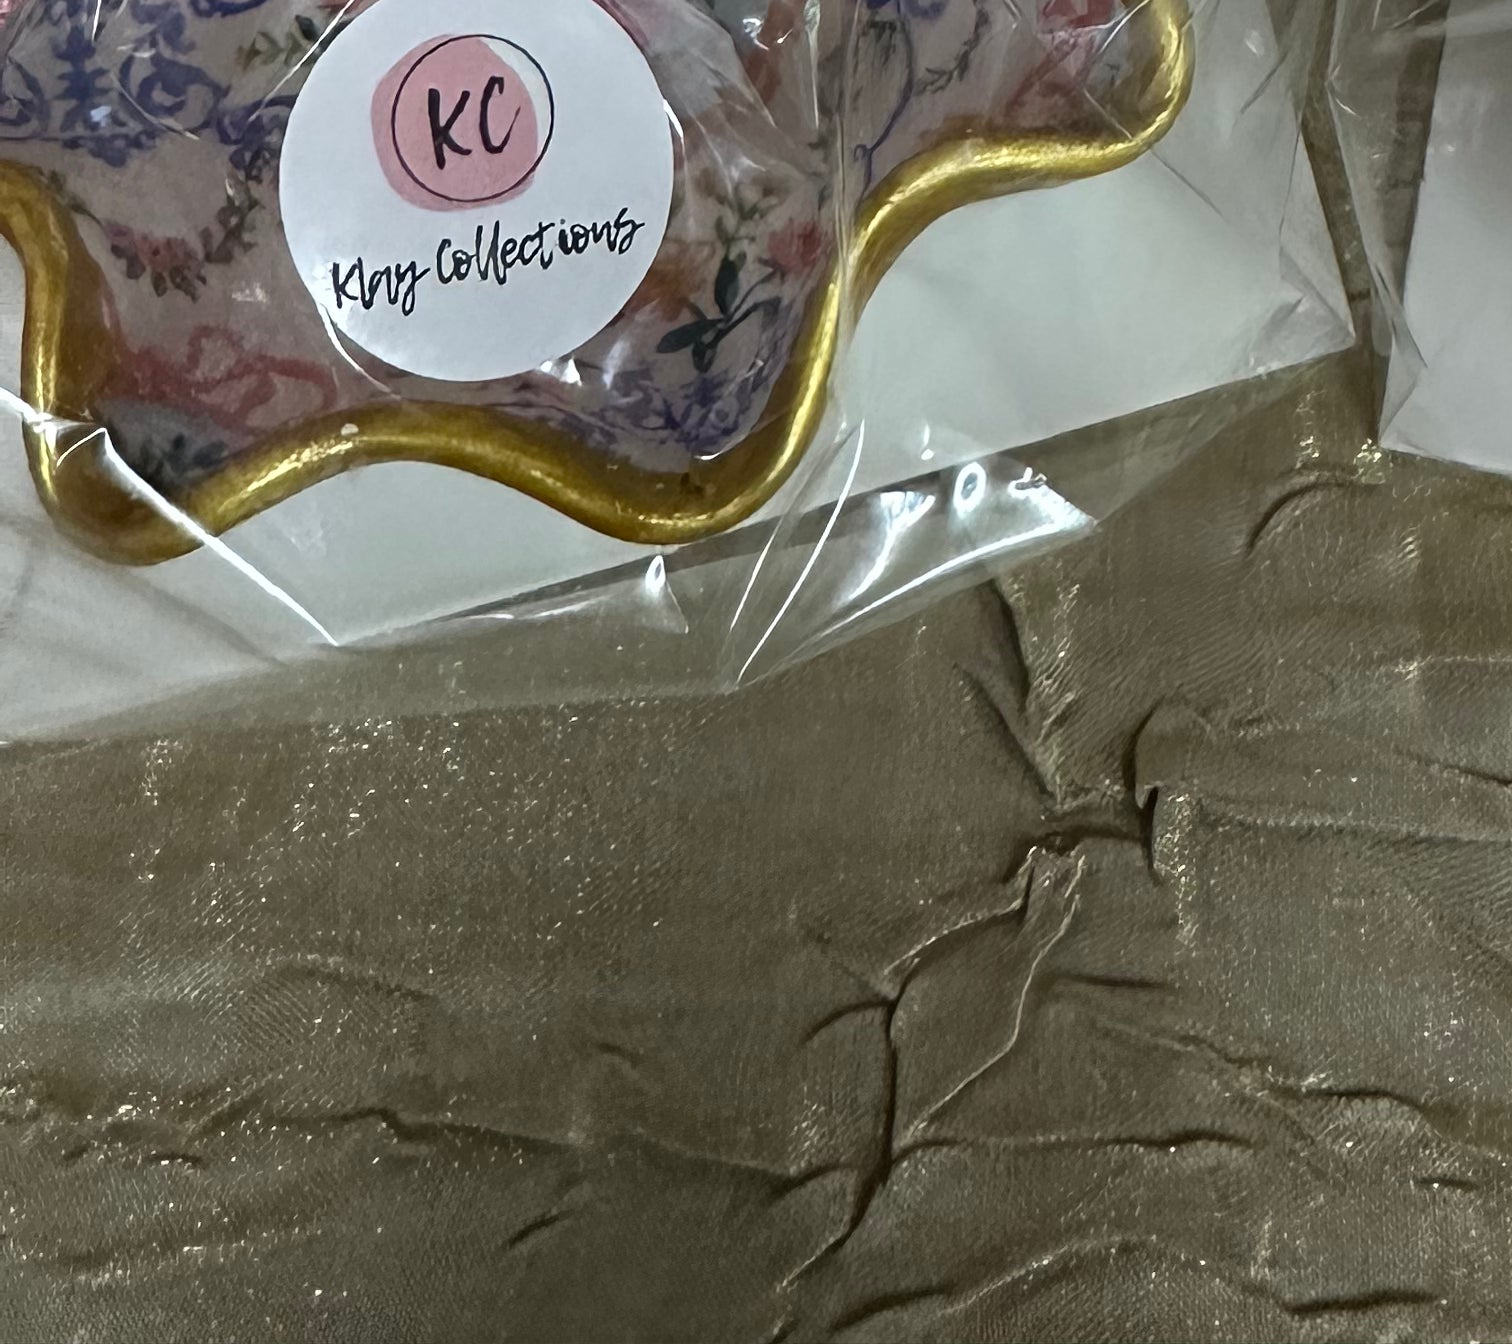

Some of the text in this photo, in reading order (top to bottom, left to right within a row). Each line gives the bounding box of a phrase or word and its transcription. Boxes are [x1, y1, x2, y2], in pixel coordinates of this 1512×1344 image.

[427, 75, 521, 170] KC
[331, 207, 646, 317] Klay Collections
